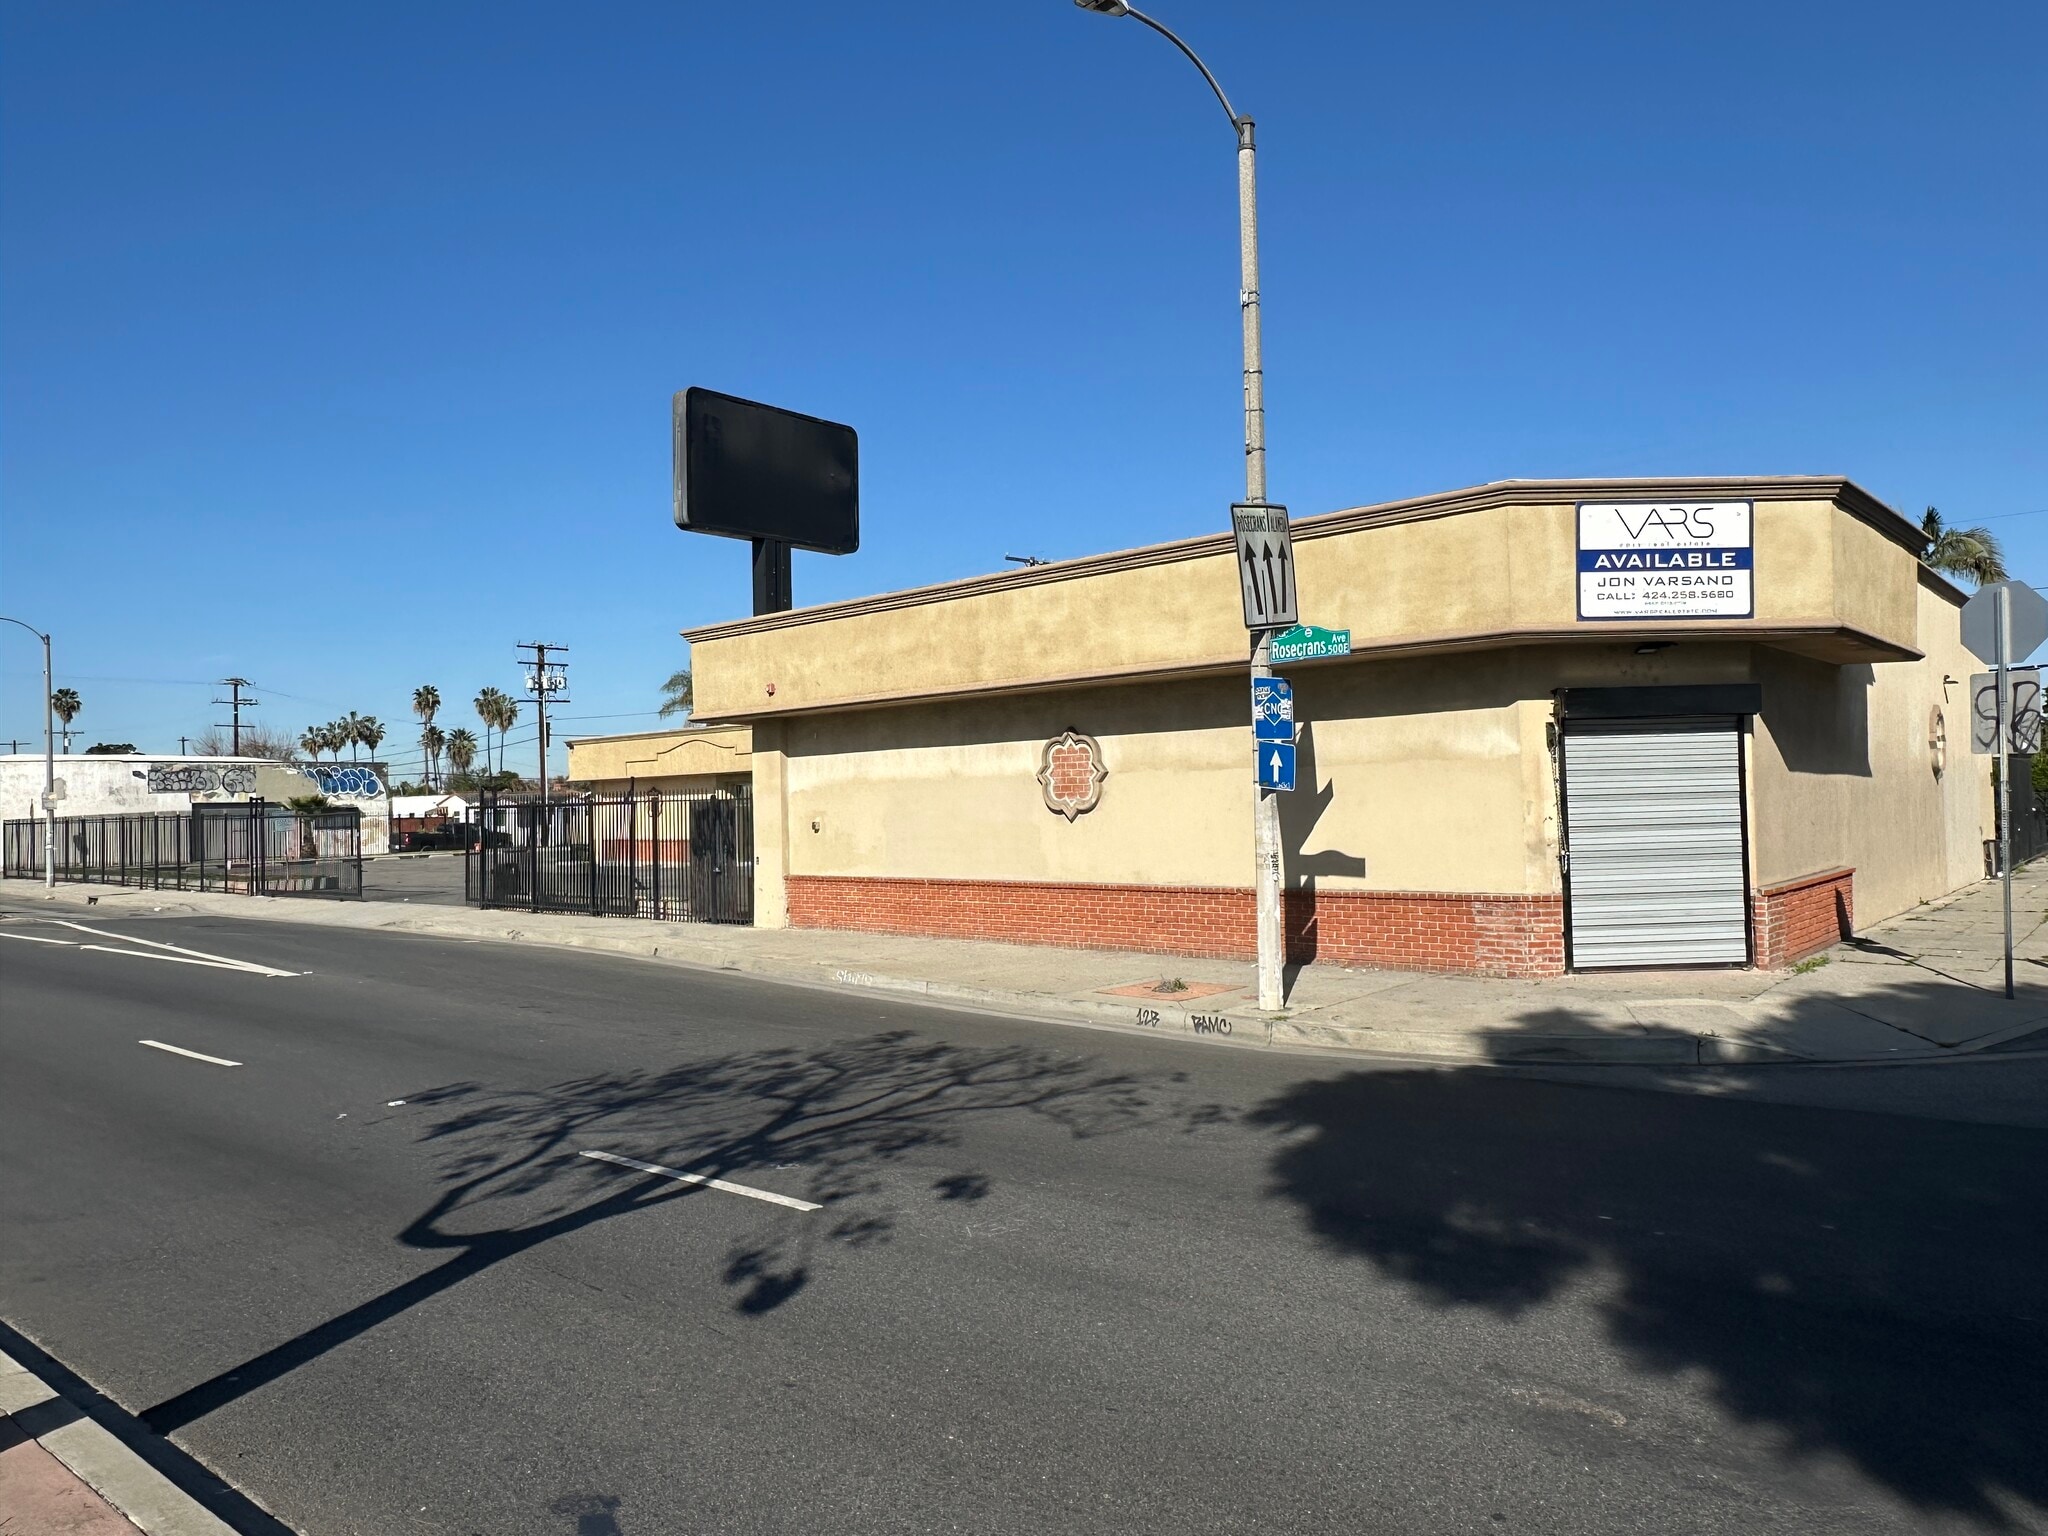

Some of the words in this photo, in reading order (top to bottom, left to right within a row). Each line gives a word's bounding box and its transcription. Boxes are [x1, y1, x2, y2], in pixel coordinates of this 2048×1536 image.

[1614, 507, 1715, 540] VARS
[1594, 552, 1736, 569] AVAILABLE
[1597, 577, 1635, 587] JON
[1642, 575, 1734, 587] VARSANO
[1597, 592, 1636, 600] CALL:
[1331, 634, 1346, 644] Ave
[1272, 641, 1327, 659] Rosecrans
[1327, 643, 1349, 655] 500E
